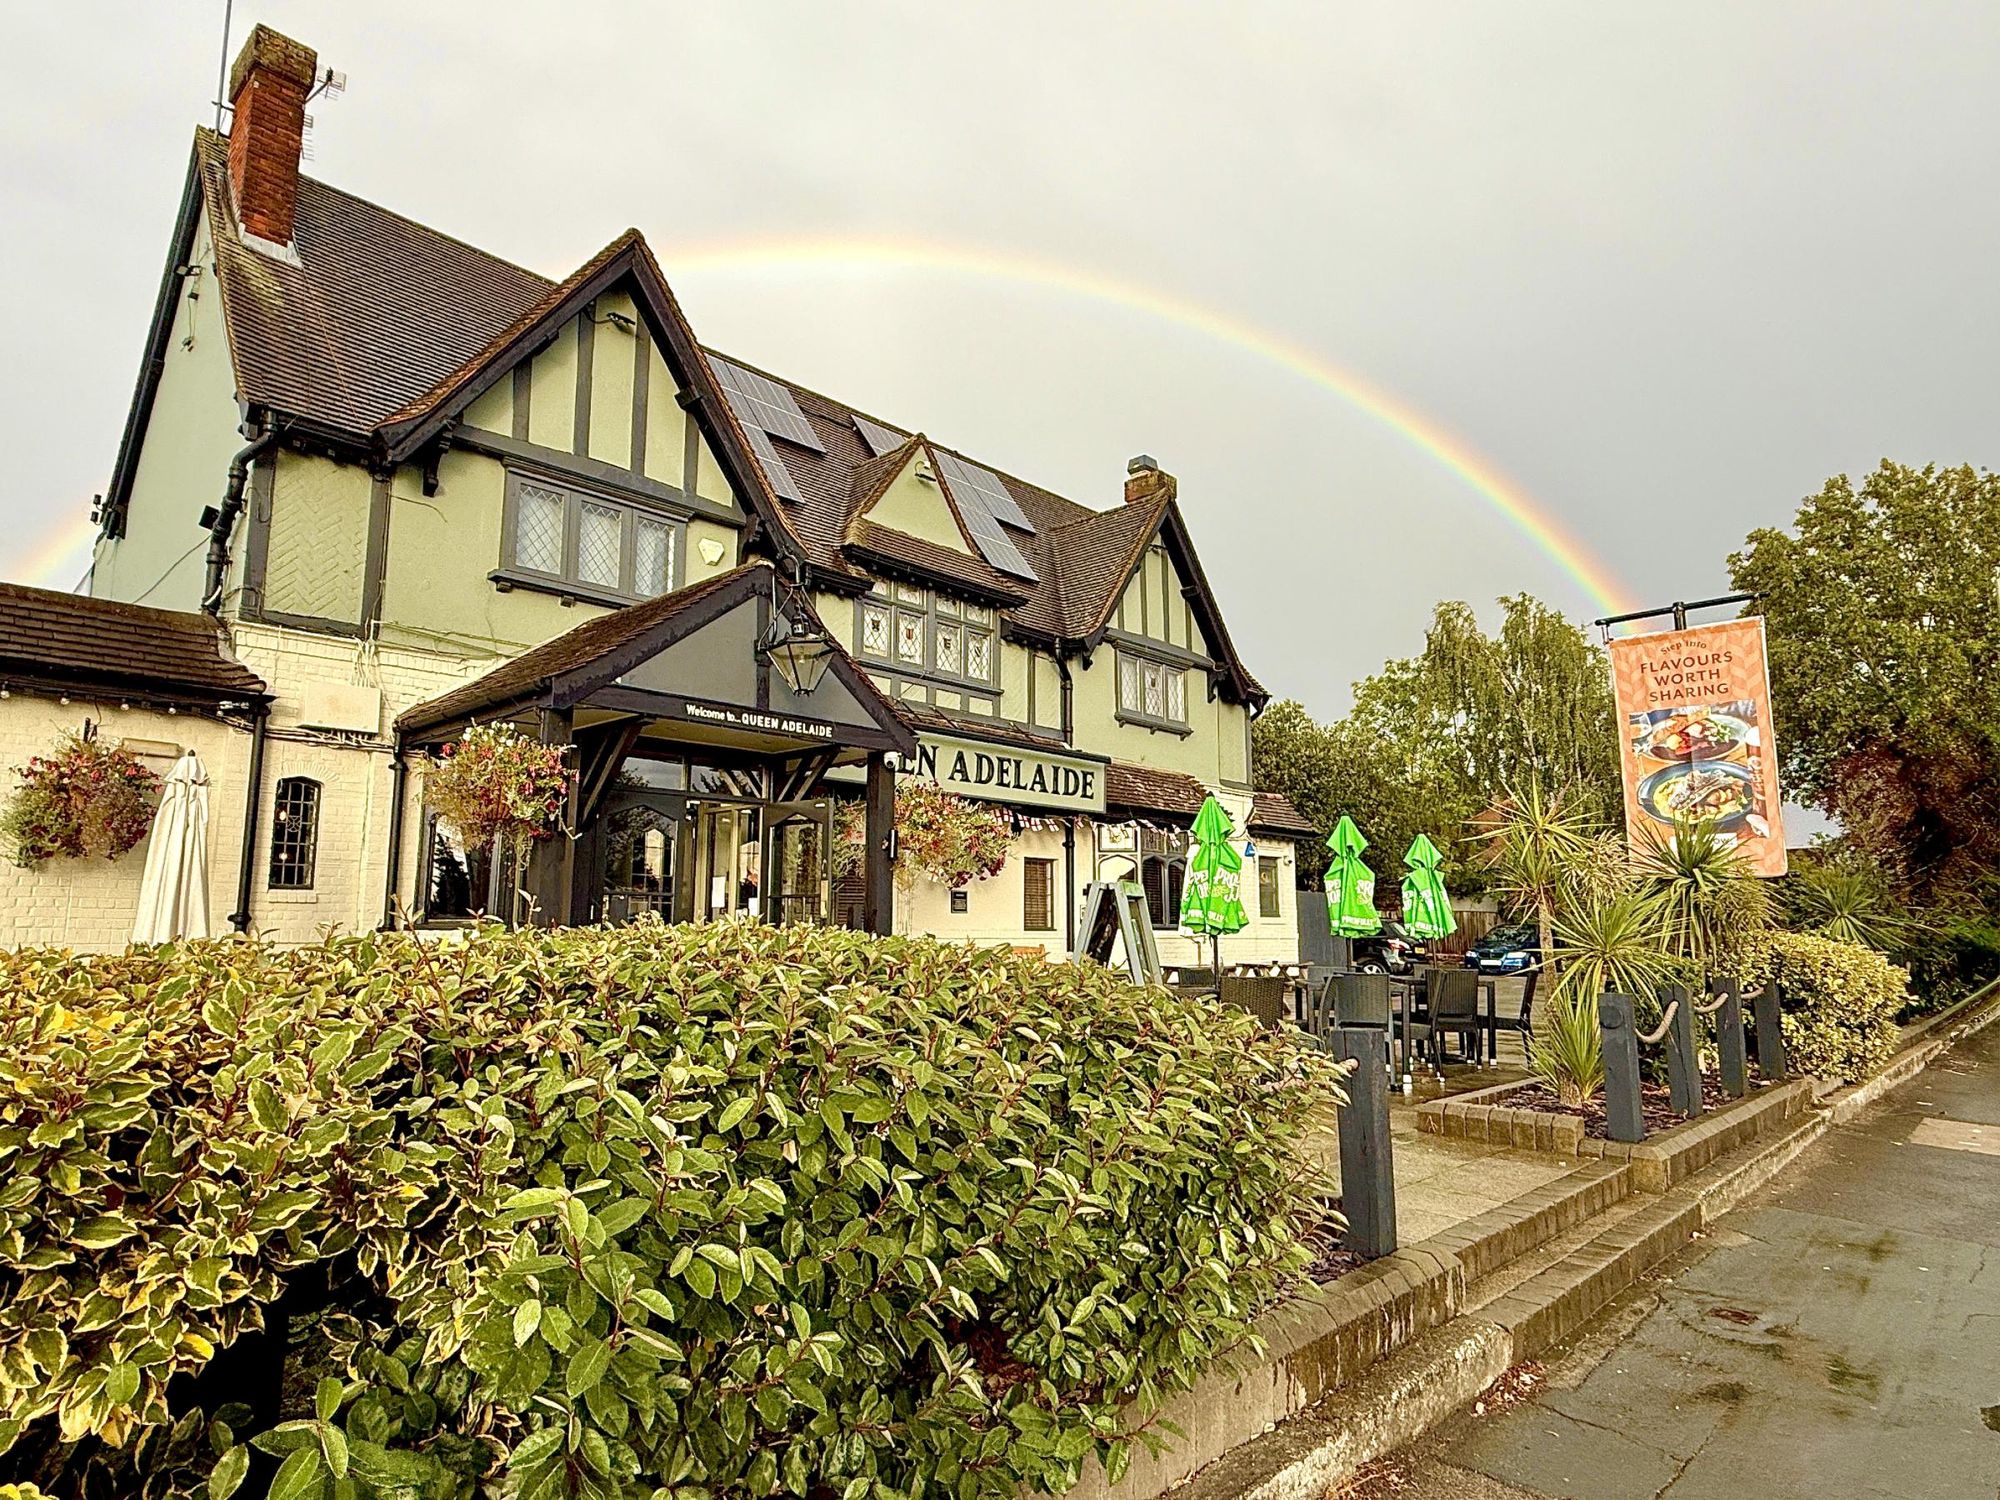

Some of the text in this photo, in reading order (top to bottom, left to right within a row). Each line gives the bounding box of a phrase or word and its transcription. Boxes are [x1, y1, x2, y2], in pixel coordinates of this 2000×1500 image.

[1640, 651, 1733, 674] FLAVOURS
[1654, 668, 1720, 686] WORTH
[1649, 683, 1729, 702] SHARING
[686, 704, 725, 720] Welcome
[742, 713, 778, 730] QUEEN
[781, 720, 832, 738] ADELAIDE
[947, 750, 1095, 800] ADELAIDE
